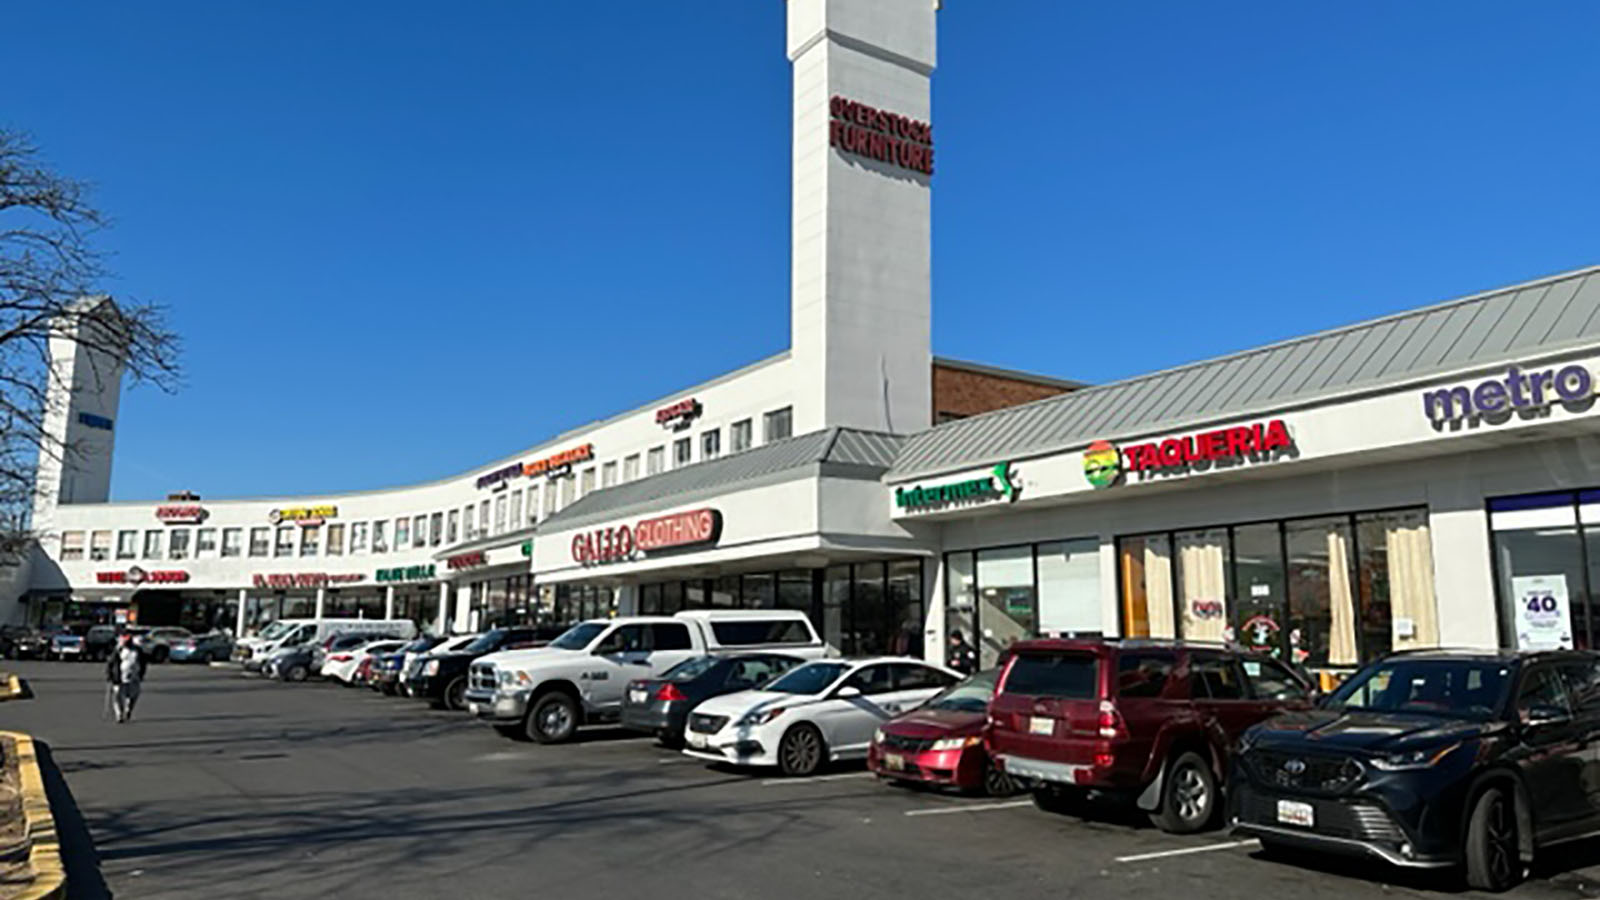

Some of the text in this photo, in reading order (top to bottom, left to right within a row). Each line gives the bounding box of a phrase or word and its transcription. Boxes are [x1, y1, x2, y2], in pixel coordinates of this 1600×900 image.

[830, 96, 932, 145] OVERSTOCK
[830, 120, 934, 175] FURNITURE
[1423, 364, 1590, 422] metro
[1123, 419, 1290, 472] TAQUERIA
[572, 525, 632, 563] GALLO
[636, 510, 713, 548] CLOTHING
